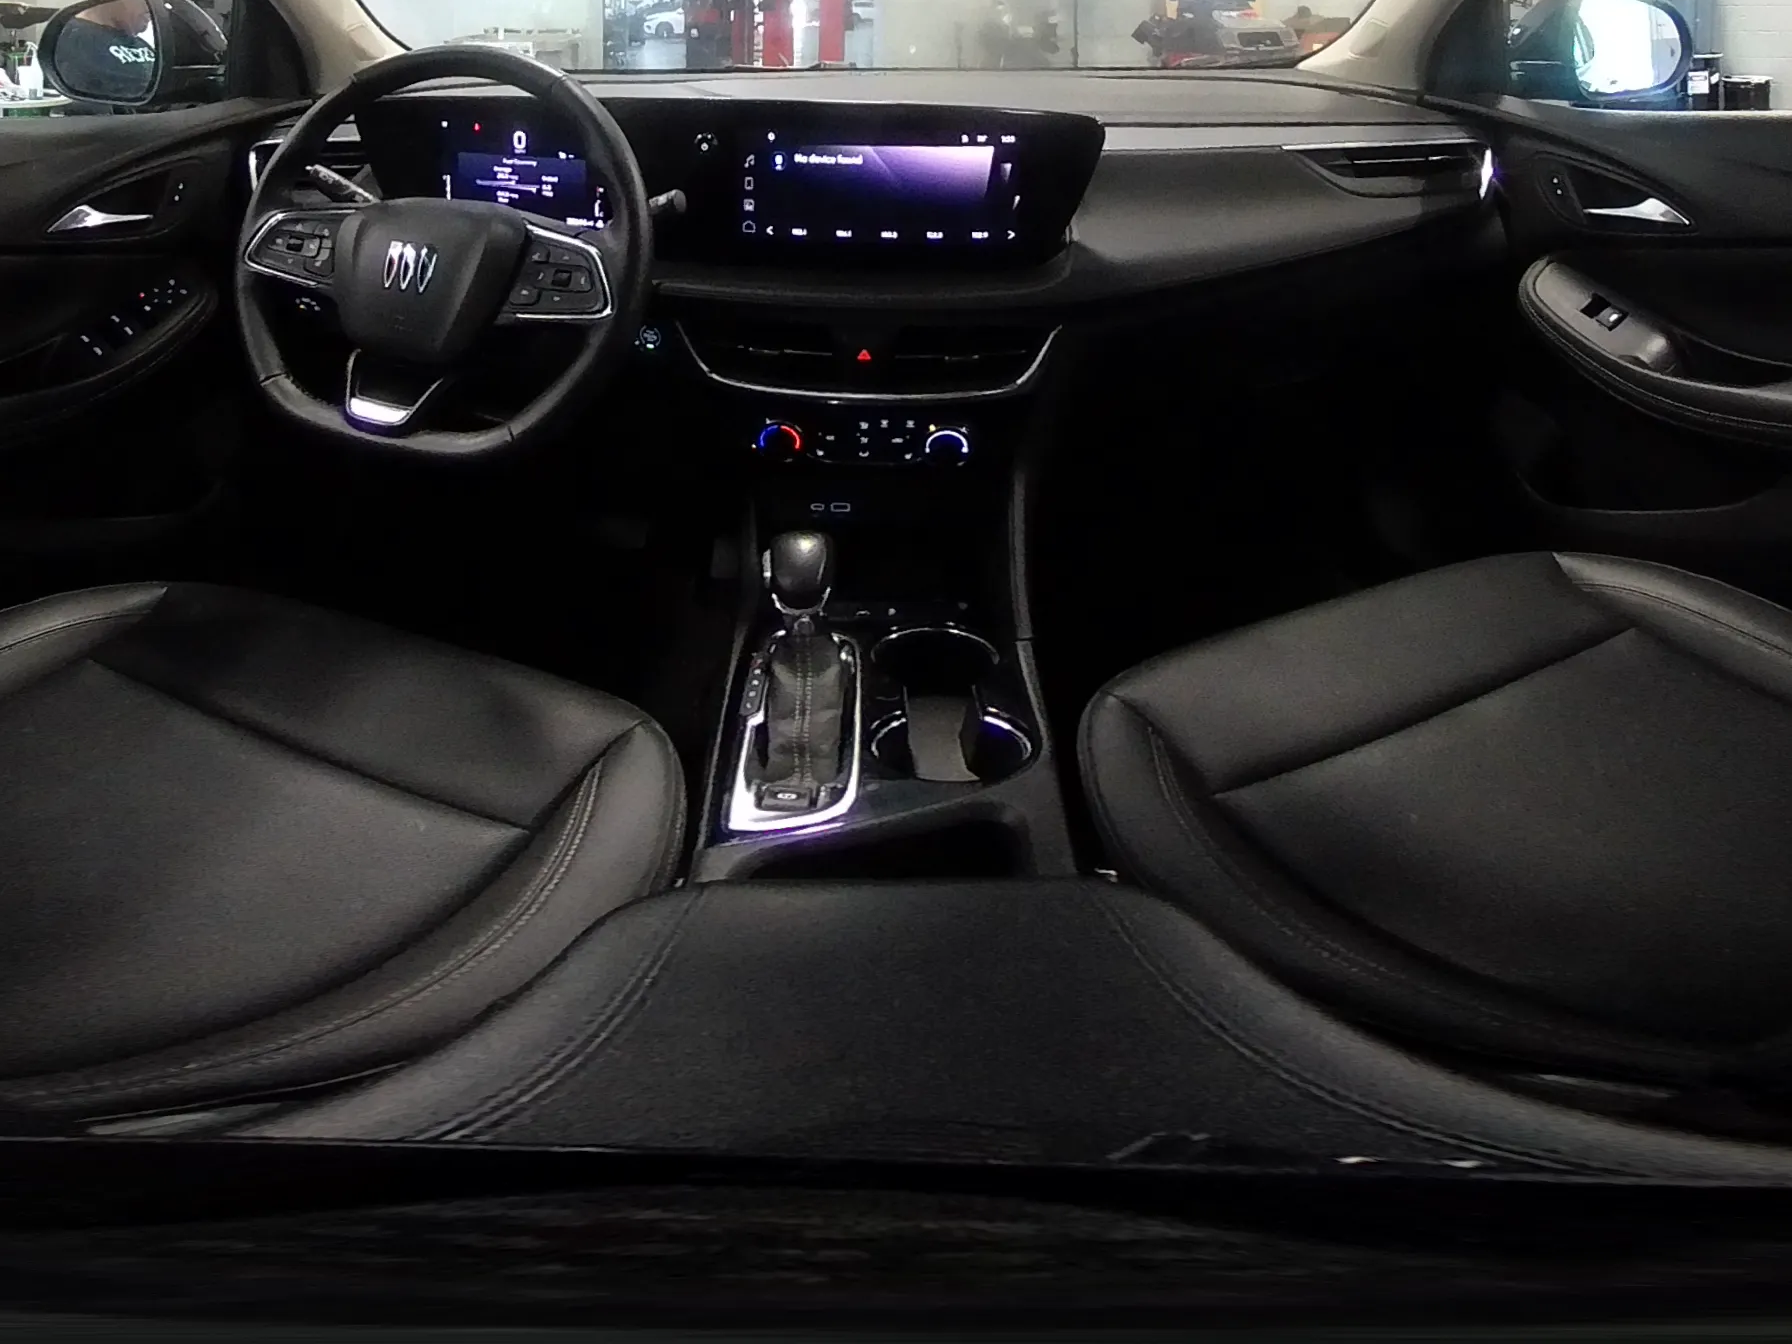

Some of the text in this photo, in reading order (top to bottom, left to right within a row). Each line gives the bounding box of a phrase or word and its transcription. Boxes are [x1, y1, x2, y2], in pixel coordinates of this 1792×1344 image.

[513, 130, 527, 149] 0
[794, 153, 864, 165] No device found
